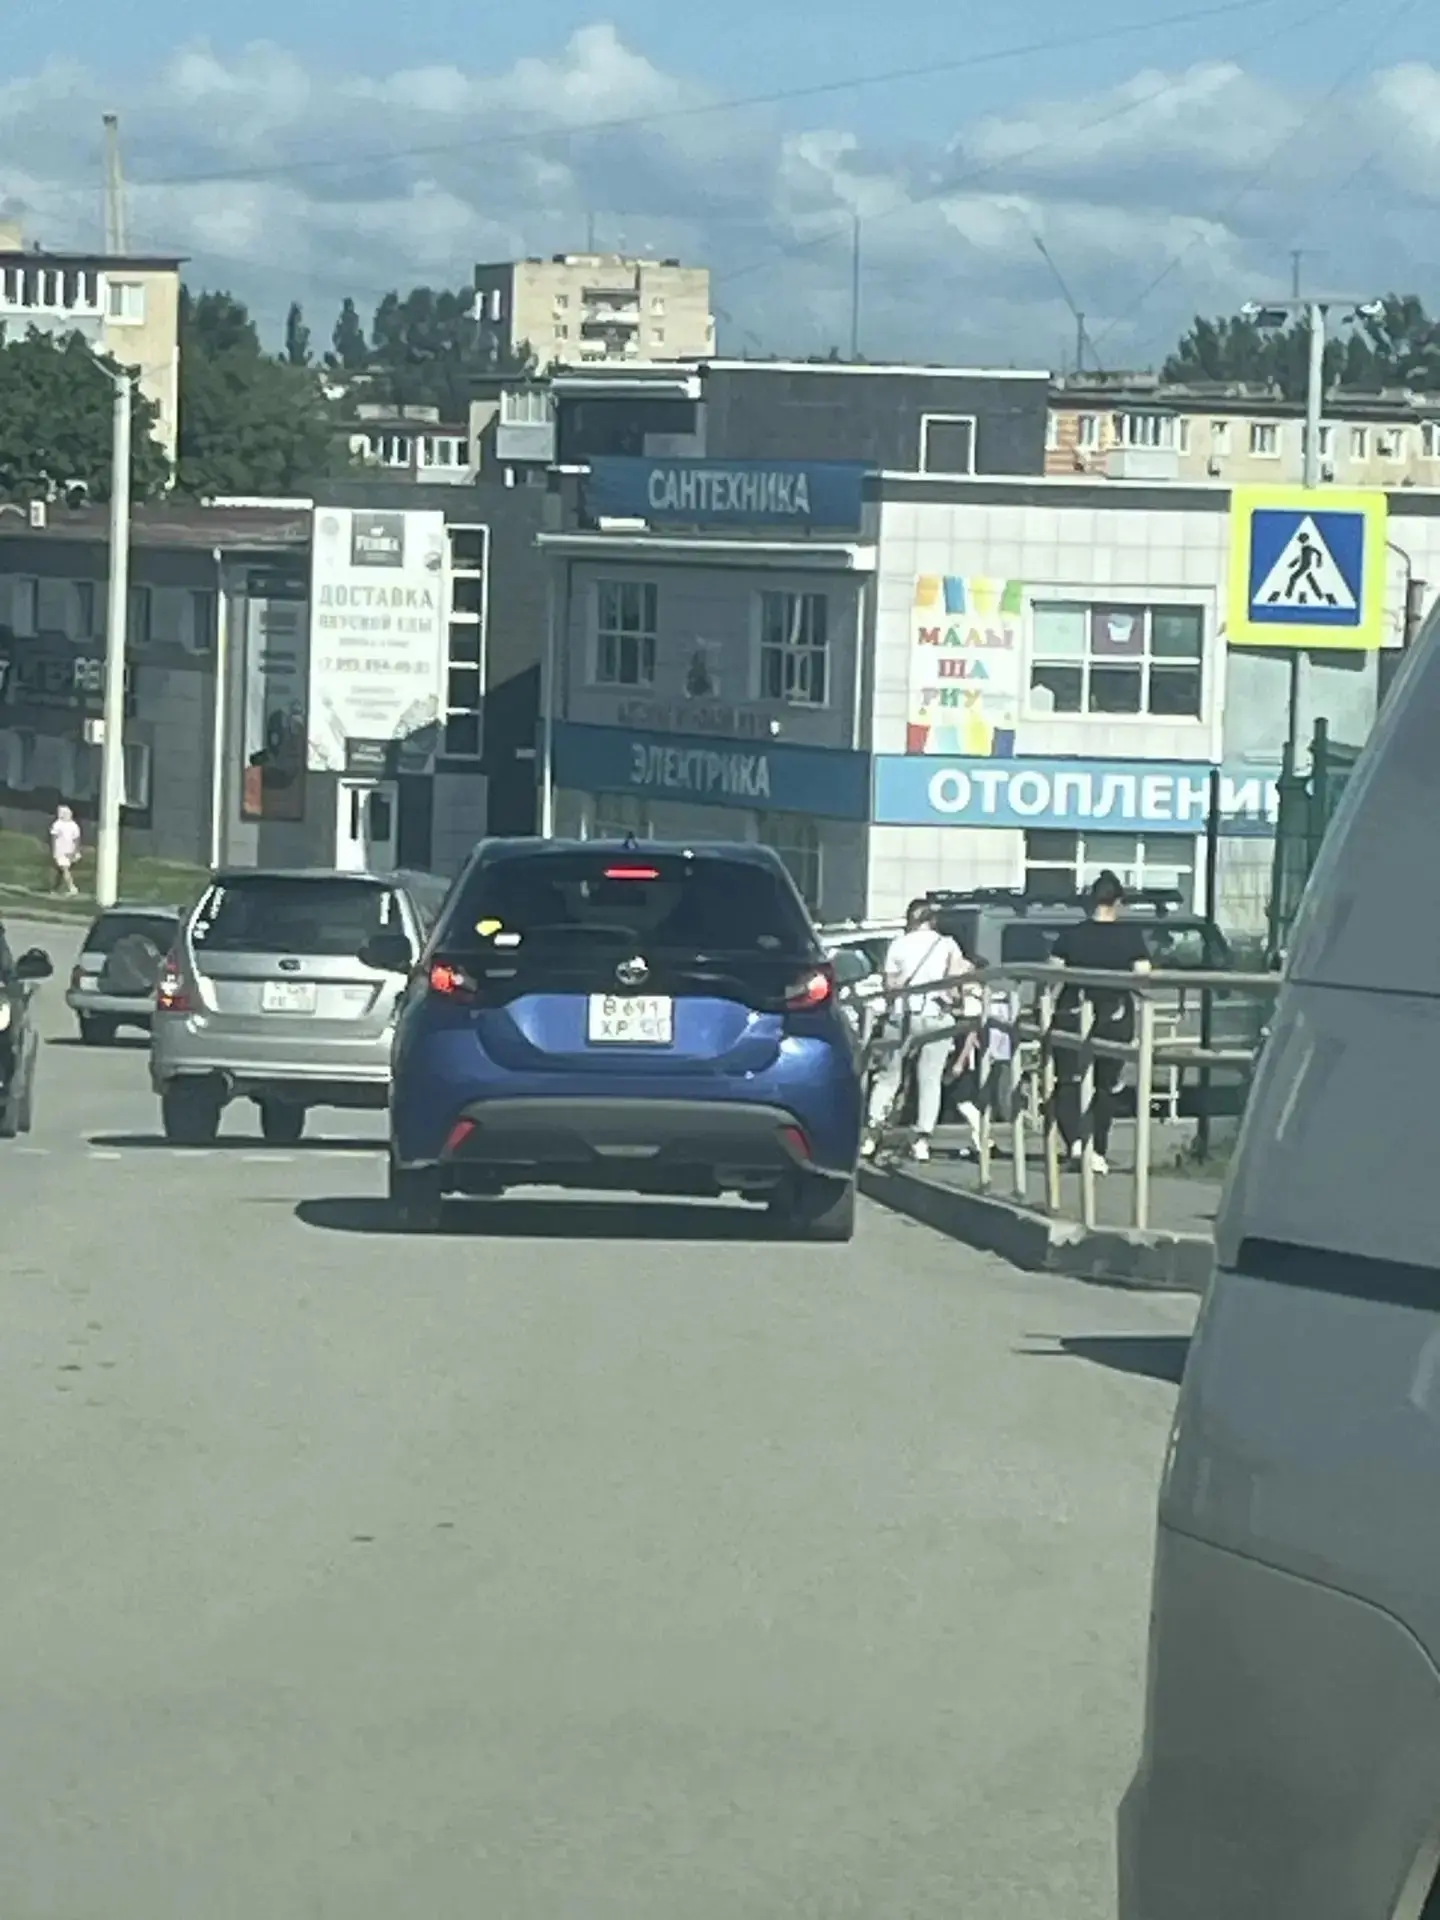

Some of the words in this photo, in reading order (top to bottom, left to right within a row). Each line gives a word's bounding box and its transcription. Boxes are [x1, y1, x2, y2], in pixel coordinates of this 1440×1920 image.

[648, 468, 811, 514] САНТЕХНИКА
[319, 584, 434, 610] ДОСТАВКА
[938, 658, 989, 679] ША
[630, 743, 770, 799] ЭЛЕКТРИКА
